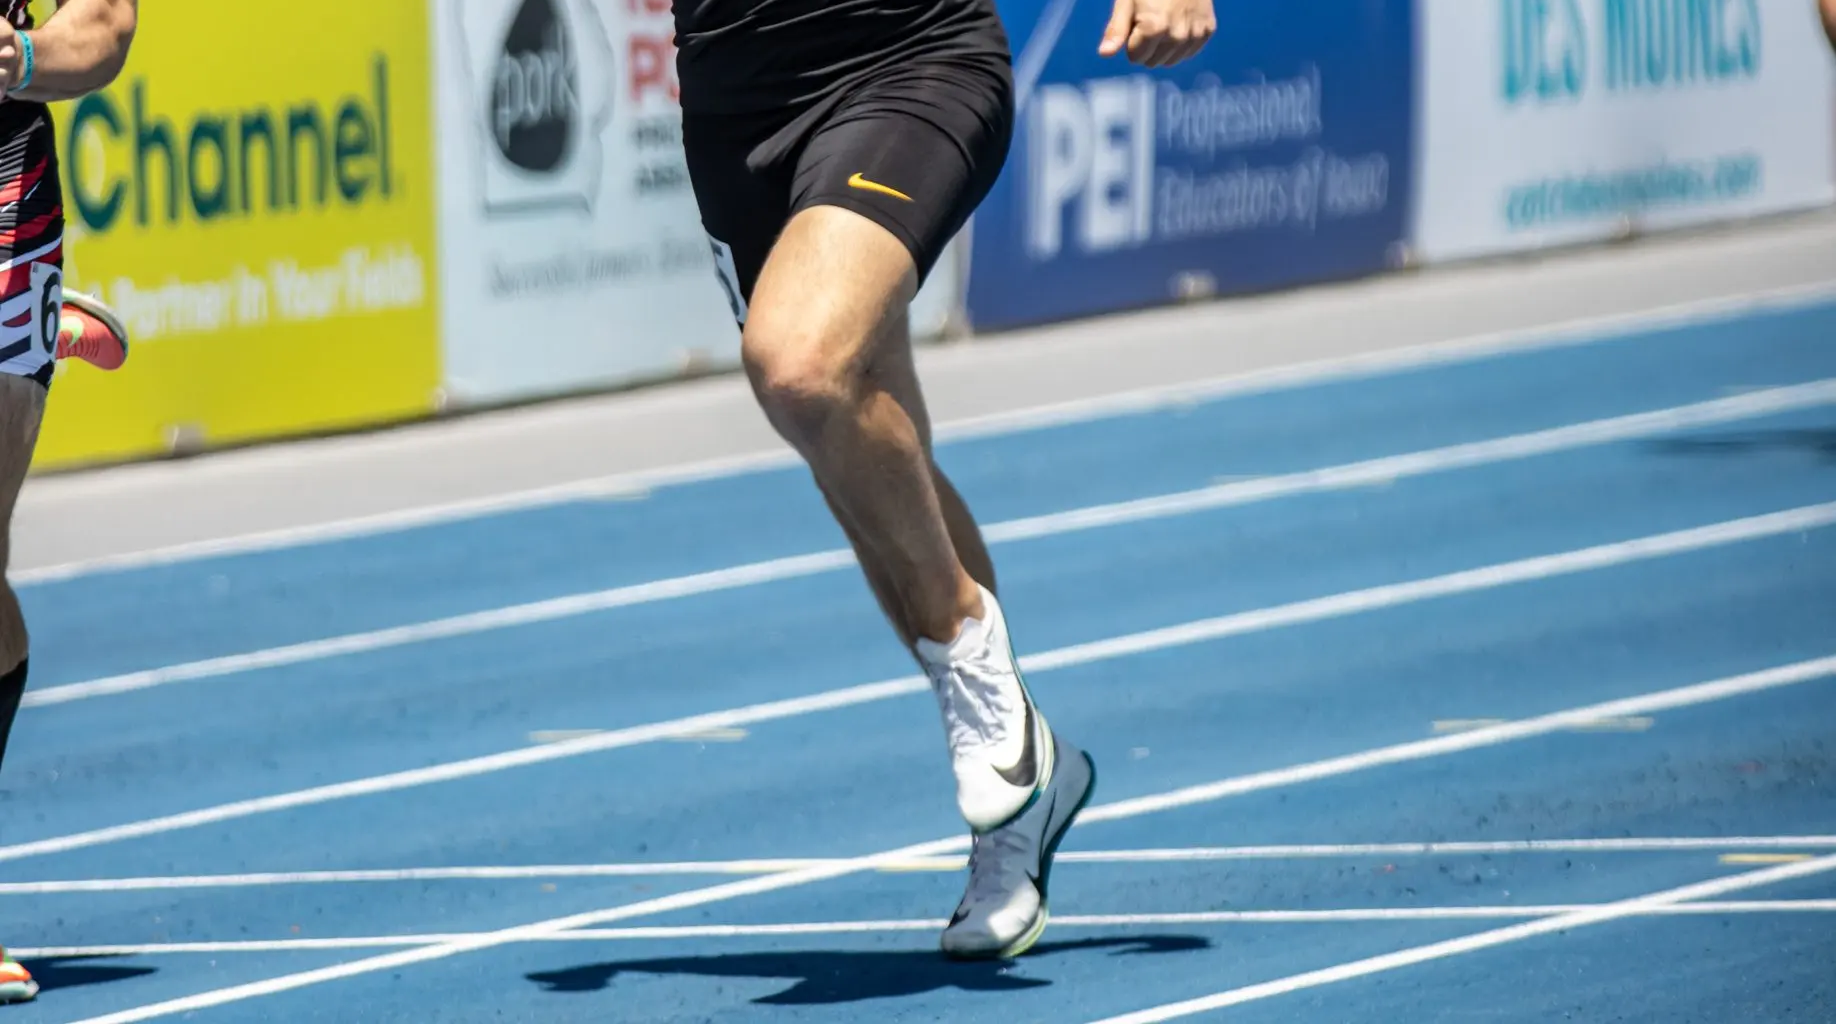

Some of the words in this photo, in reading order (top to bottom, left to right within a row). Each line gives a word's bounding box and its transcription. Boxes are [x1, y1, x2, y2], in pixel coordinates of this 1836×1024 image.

[67, 54, 392, 232] Channel
[1031, 74, 1154, 259] PEI
[41, 271, 60, 354] 6
